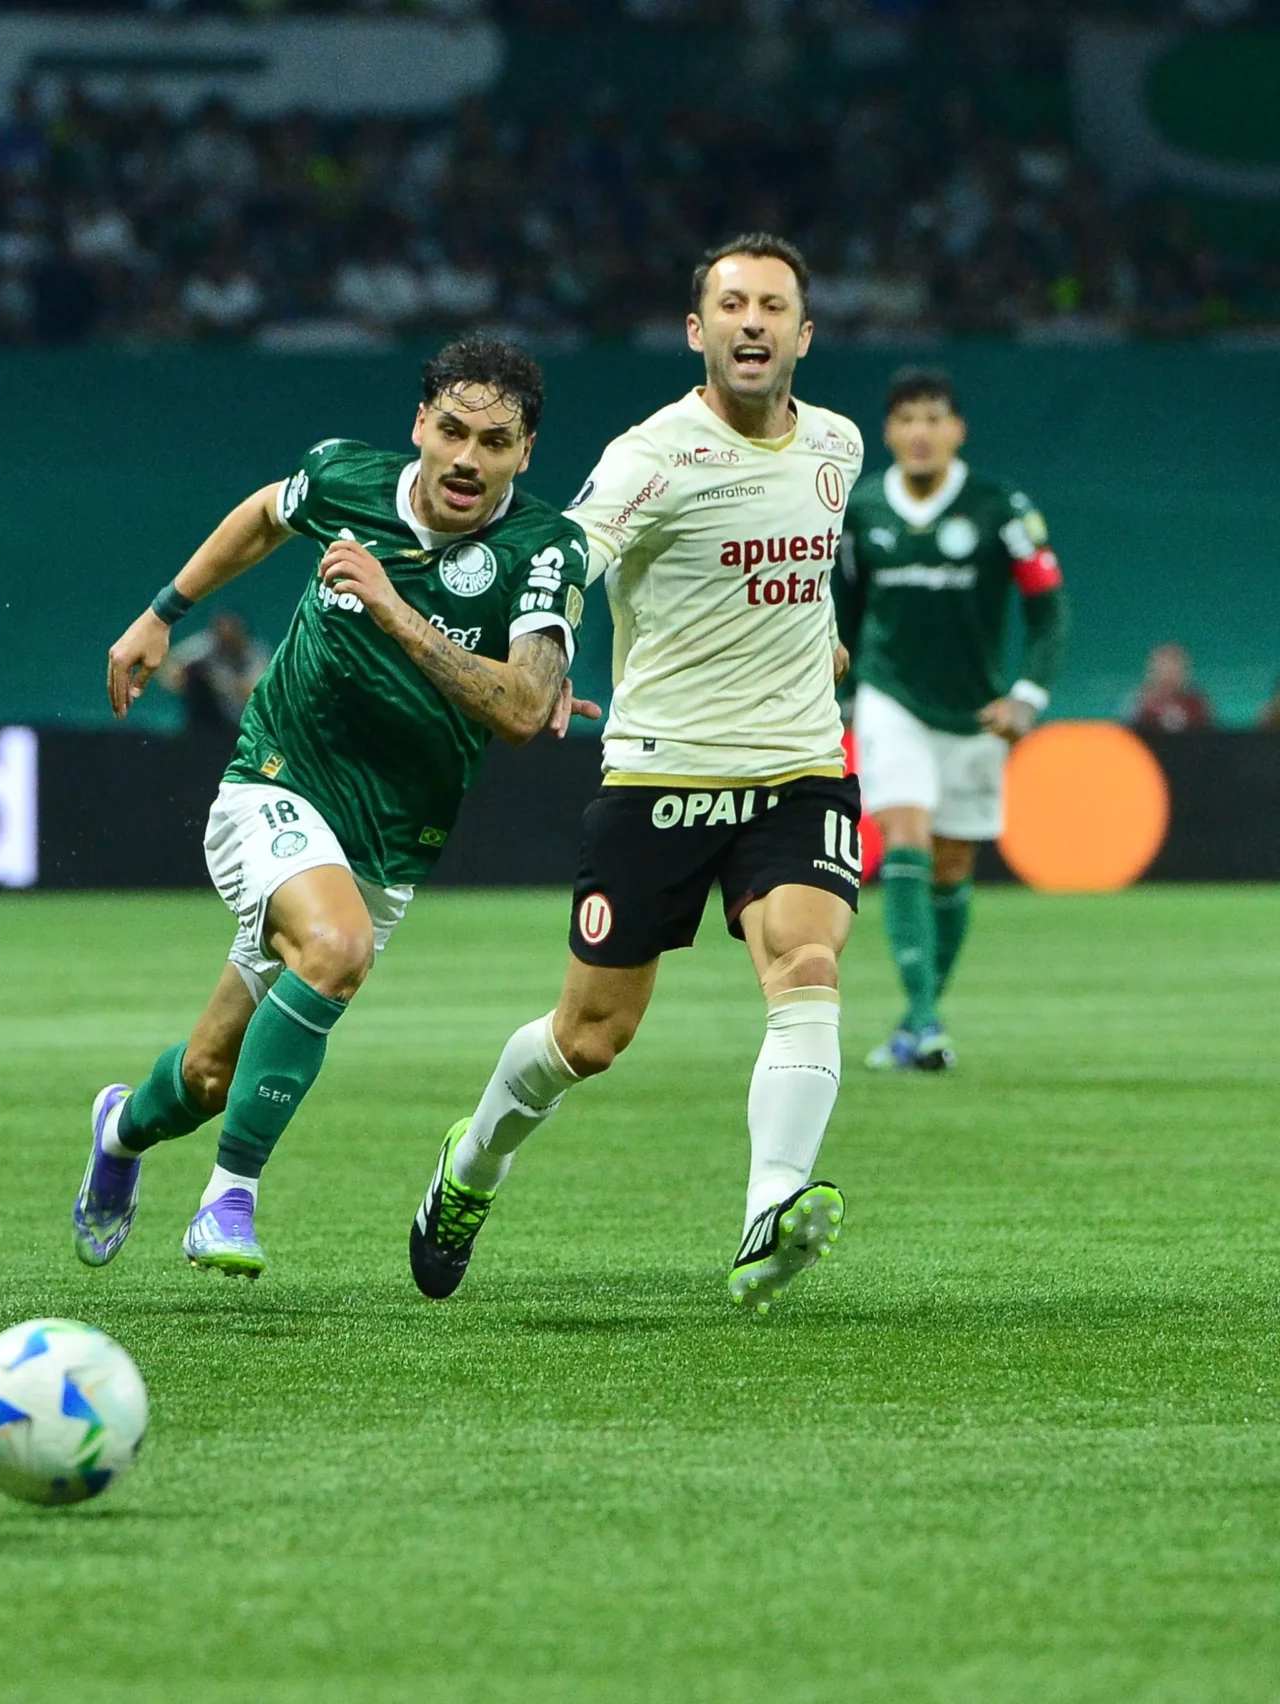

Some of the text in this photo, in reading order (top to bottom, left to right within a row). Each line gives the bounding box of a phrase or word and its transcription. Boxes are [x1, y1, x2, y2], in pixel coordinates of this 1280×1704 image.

[668, 451, 693, 468] SAN
[696, 485, 765, 502] marathon
[822, 471, 840, 507] U
[443, 560, 493, 593] PALMEIRAS
[747, 570, 823, 605] total
[259, 800, 300, 830] 18
[651, 789, 779, 830] OPAL
[585, 901, 605, 939] U
[258, 1085, 291, 1103] SEP
